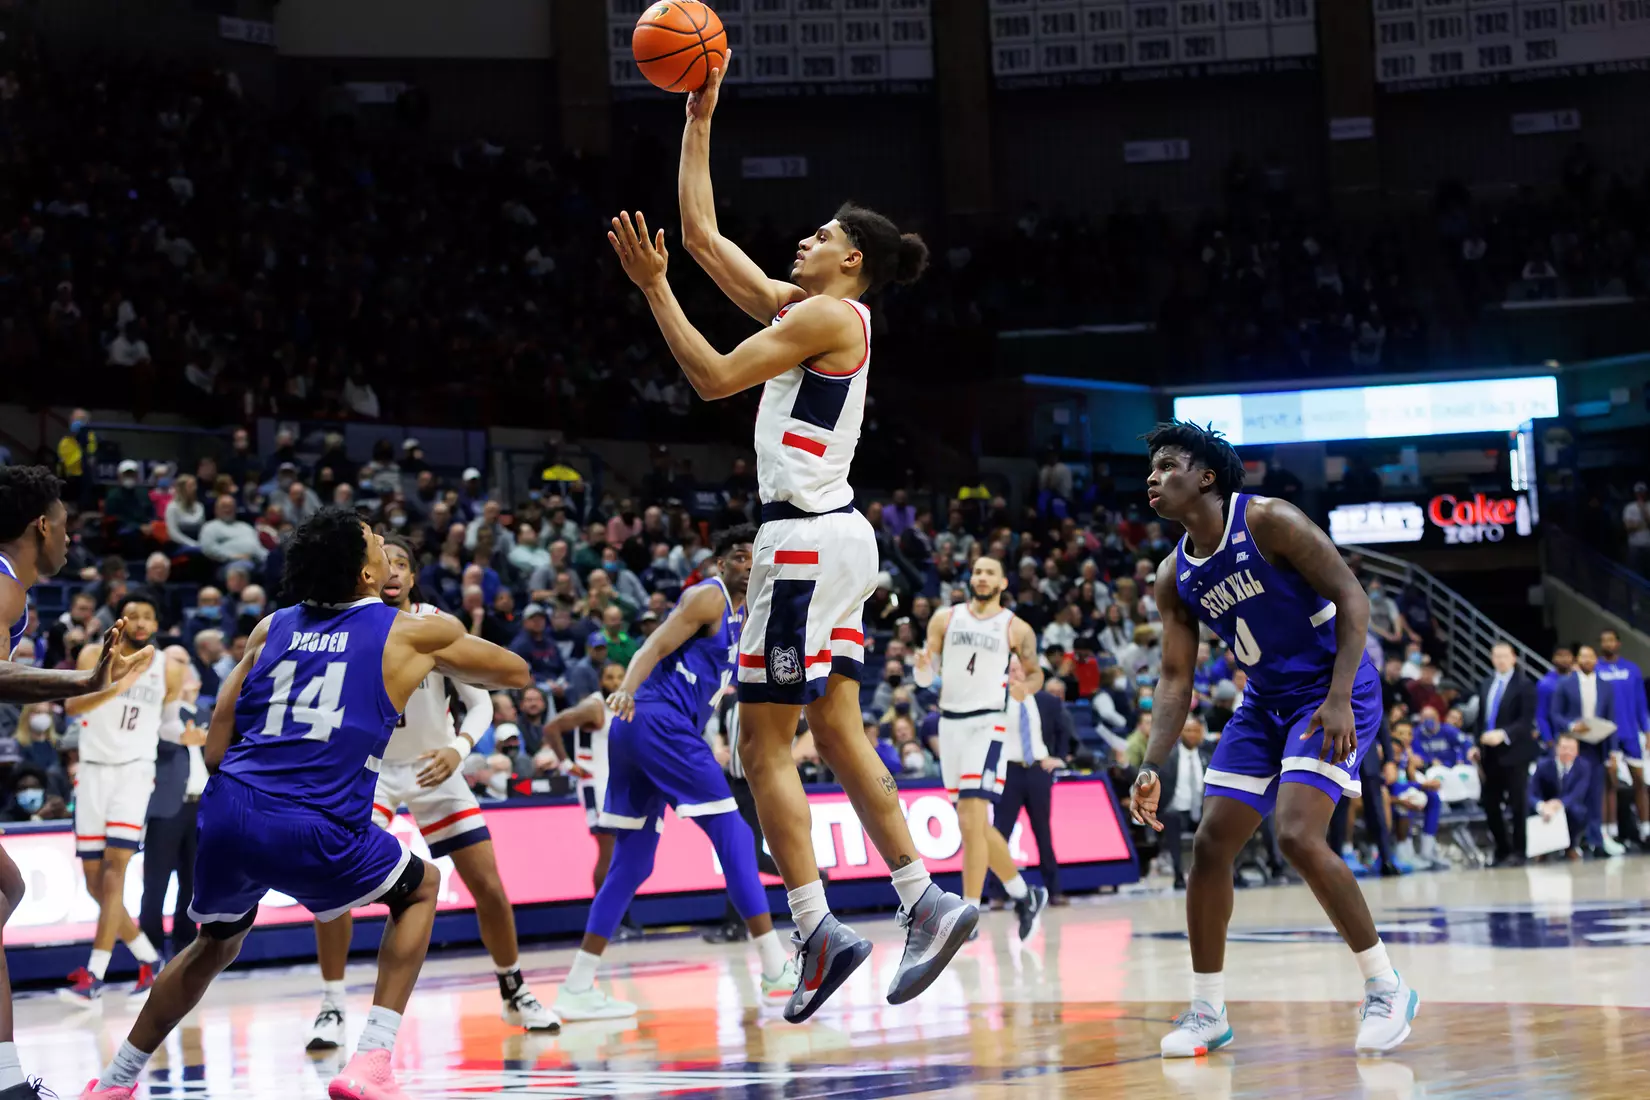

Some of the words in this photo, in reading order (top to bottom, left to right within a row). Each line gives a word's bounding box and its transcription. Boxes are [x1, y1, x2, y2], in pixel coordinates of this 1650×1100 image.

[1428, 493, 1517, 527] Coke
[1443, 522, 1505, 545] zero
[1234, 616, 1262, 667] 0
[966, 652, 977, 676] 4
[260, 659, 348, 743] 14
[120, 704, 140, 731] 12
